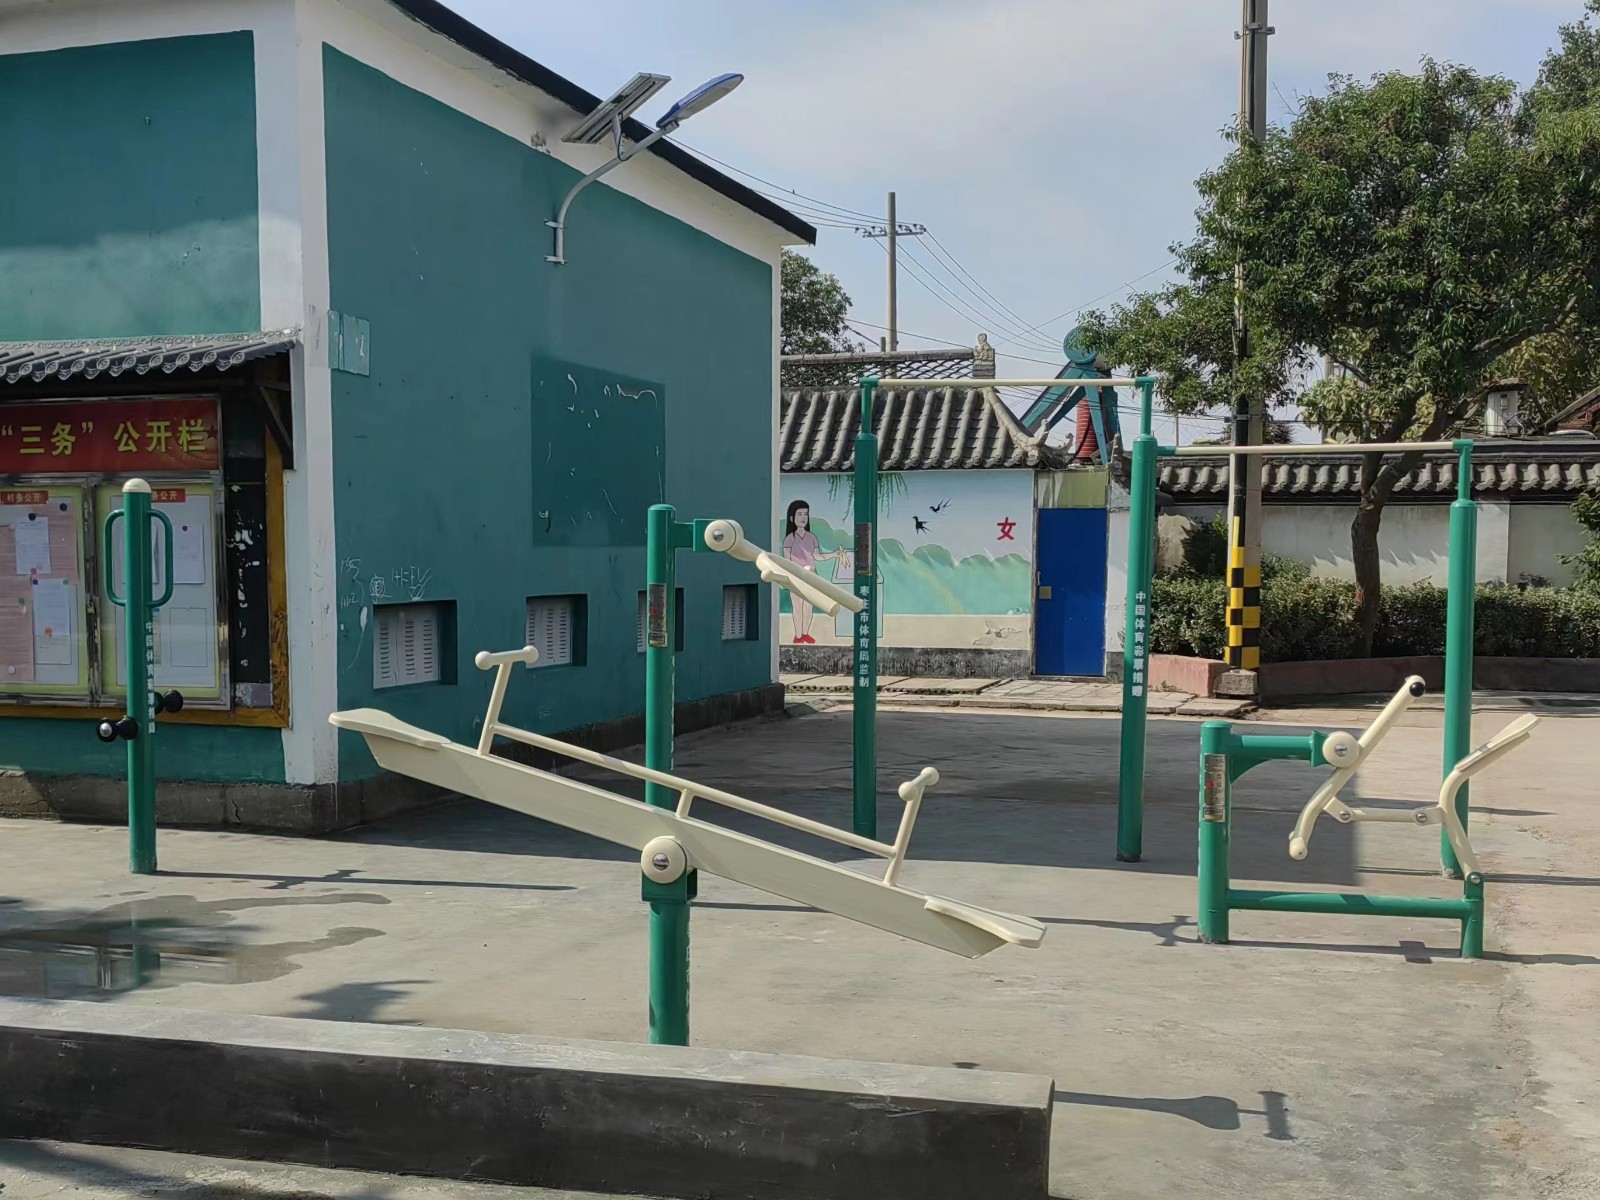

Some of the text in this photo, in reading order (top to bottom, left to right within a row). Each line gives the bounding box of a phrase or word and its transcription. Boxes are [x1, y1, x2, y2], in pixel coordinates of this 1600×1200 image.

[997, 516, 1017, 541] 女
[1131, 590, 1147, 697] 中国体育彩票捐赠
